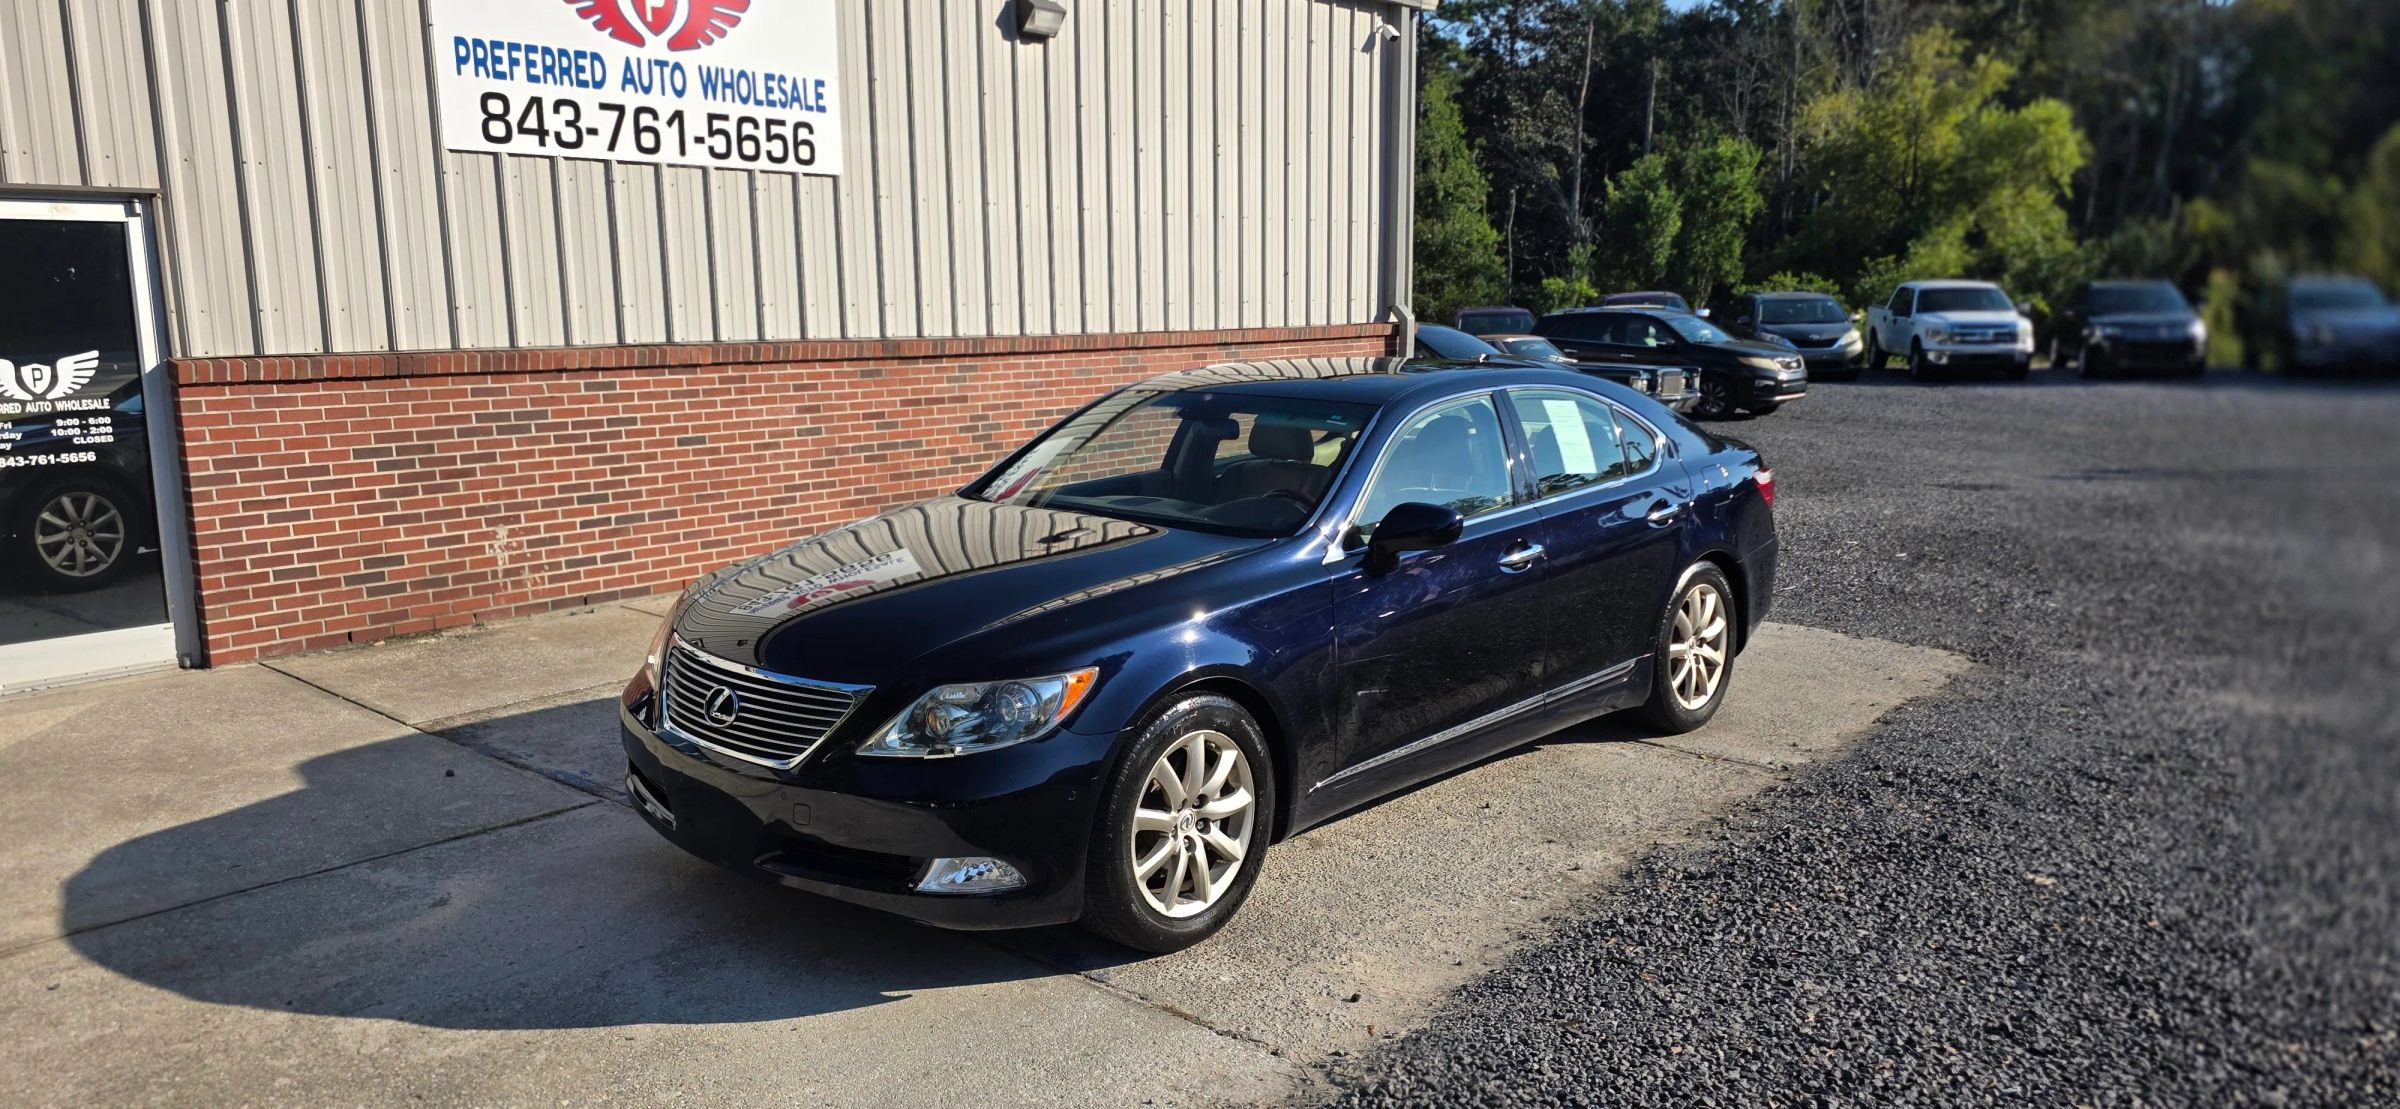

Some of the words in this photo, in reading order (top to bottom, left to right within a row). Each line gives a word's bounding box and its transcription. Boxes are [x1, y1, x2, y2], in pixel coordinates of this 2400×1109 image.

[453, 35, 607, 90] PREFERRED
[620, 55, 687, 98] AUTO
[697, 64, 828, 113] WHOLESALE
[479, 91, 816, 167] 843-761-5656
[31, 367, 43, 388] P
[25, 401, 52, 413] AUTO
[55, 398, 110, 412] WHOLESALE
[56, 418, 79, 426] 9:00
[88, 417, 111, 425] 6:00
[50, 427, 81, 437] 10:00
[89, 426, 113, 434] 2:00
[73, 435, 114, 444] CLOSED
